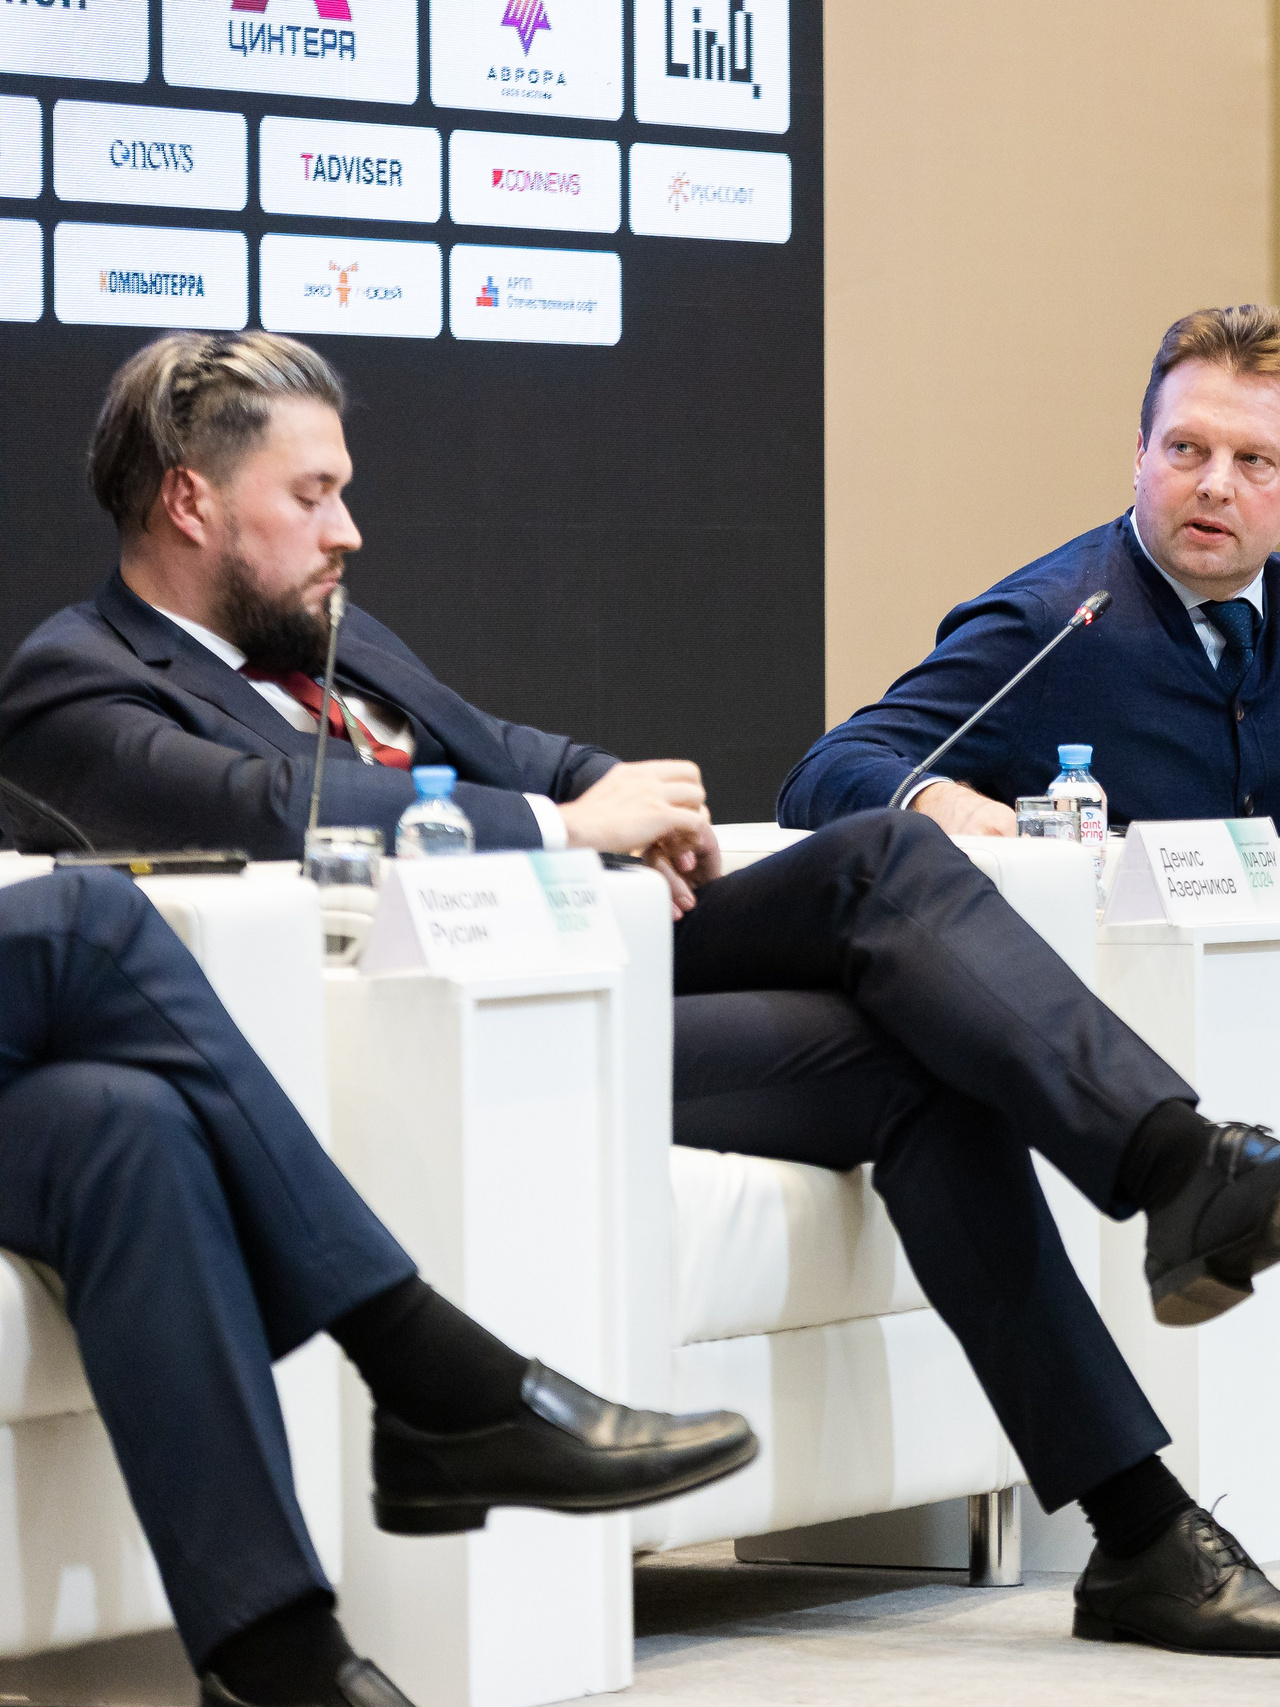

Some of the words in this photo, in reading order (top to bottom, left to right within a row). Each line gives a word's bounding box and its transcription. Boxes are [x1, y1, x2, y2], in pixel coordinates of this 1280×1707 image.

[228, 20, 356, 61] ЦИНТЕРА
[487, 65, 567, 86] АВРОРА
[300, 152, 403, 187] TADVISER
[1159, 847, 1205, 873] Денис
[1242, 851, 1261, 868] IVA
[1258, 851, 1278, 868] DAY
[1167, 875, 1238, 901] Азерников
[1249, 871, 1274, 888] 2024
[418, 888, 500, 913] Максим
[429, 921, 490, 950] Русин
